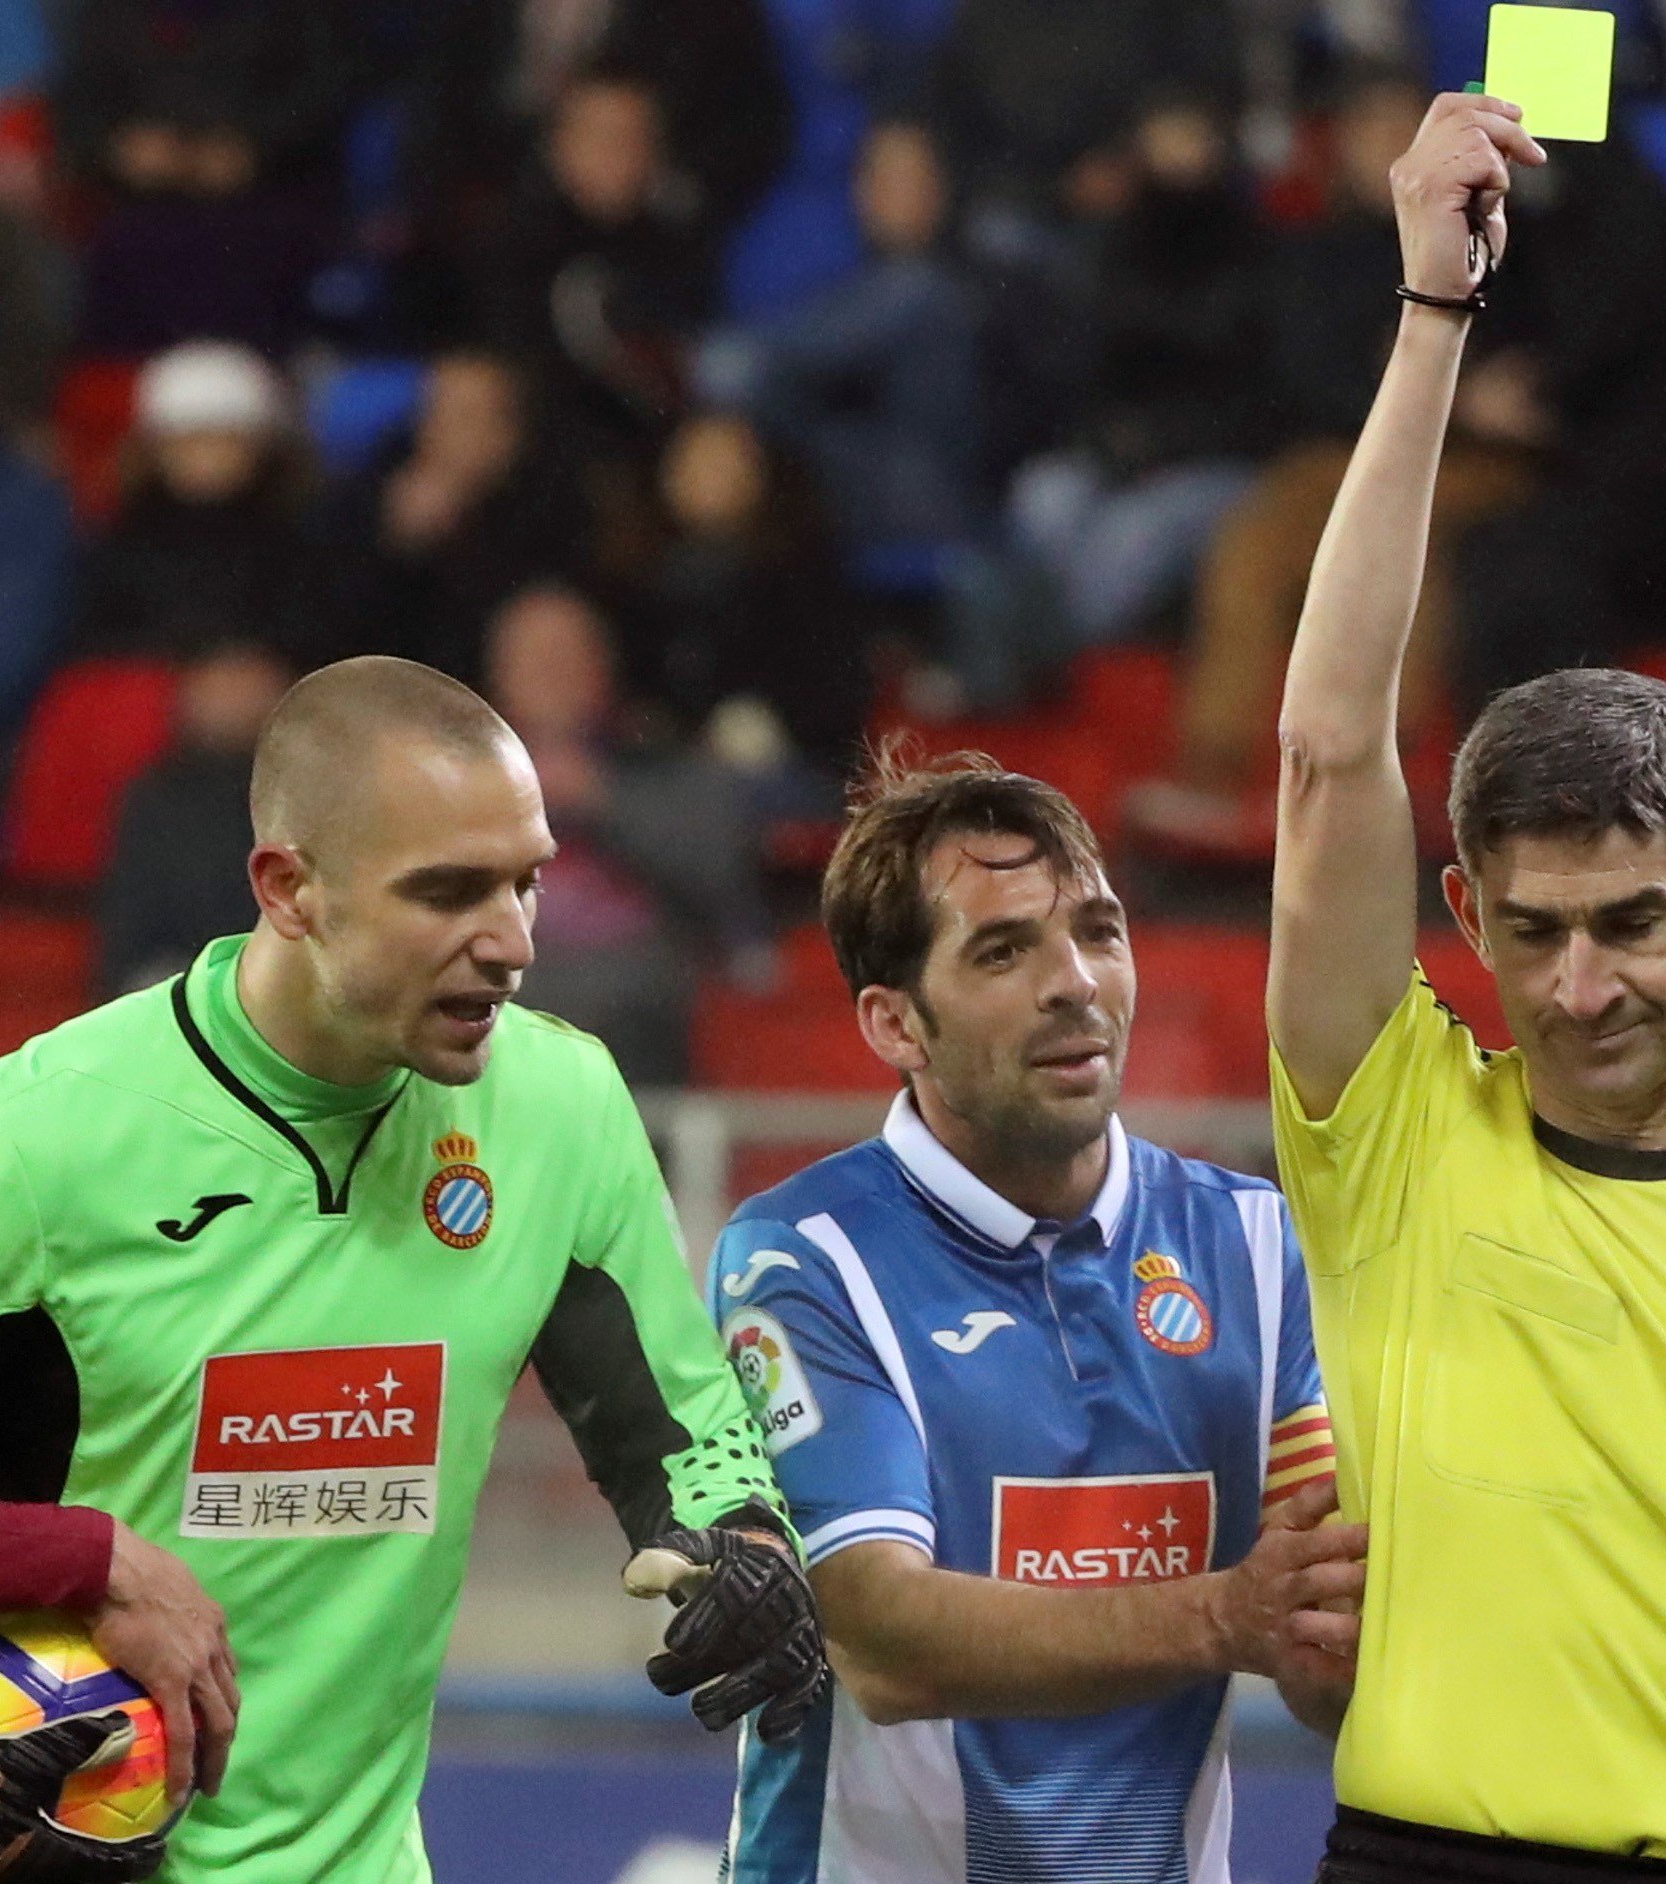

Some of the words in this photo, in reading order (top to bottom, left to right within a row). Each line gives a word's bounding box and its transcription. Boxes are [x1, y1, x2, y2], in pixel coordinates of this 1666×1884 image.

[219, 1407, 416, 1444] RASTAR
[188, 1478, 429, 1528] 星辉娱乐
[1014, 1545, 1190, 1581] RASTAR
